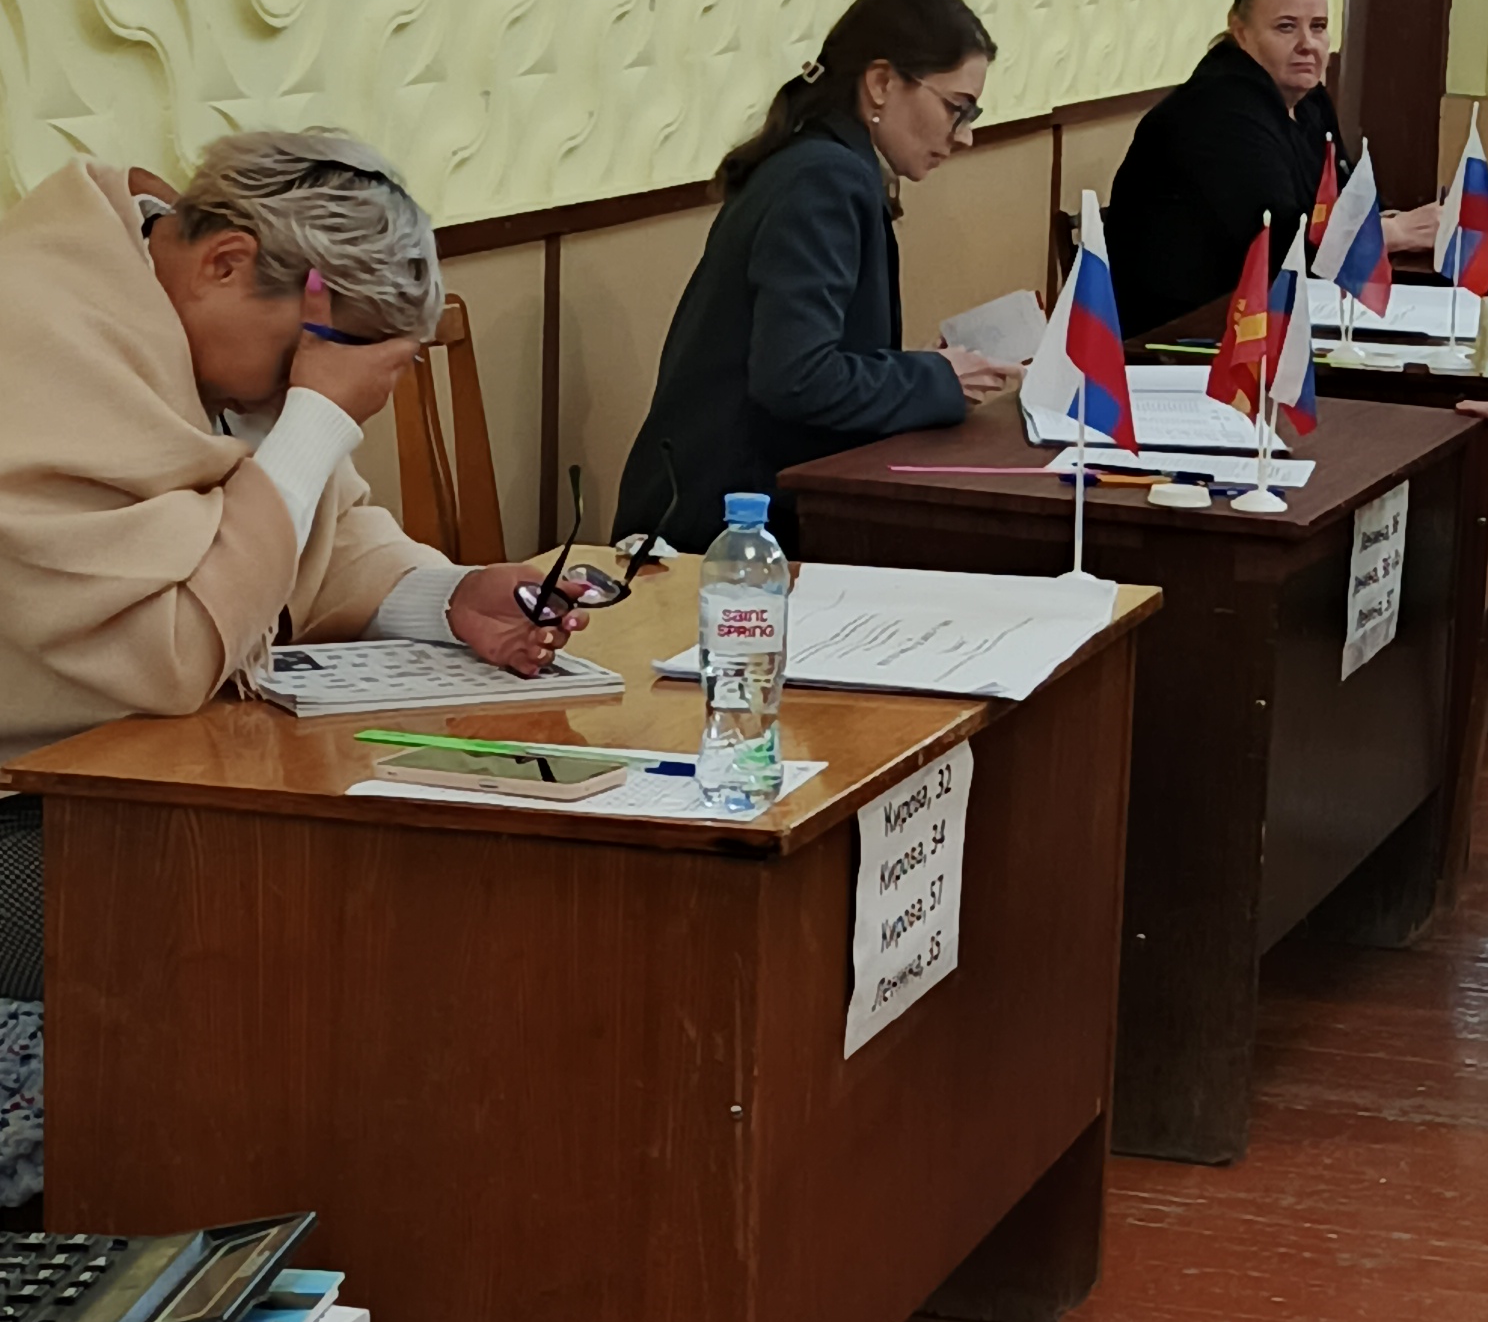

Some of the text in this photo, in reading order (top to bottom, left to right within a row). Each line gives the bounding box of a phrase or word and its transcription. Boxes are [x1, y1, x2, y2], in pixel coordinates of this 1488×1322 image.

[882, 763, 953, 837] Кирова, 32
[878, 840, 928, 895] Кирова,
[879, 897, 927, 954] Кирова,
